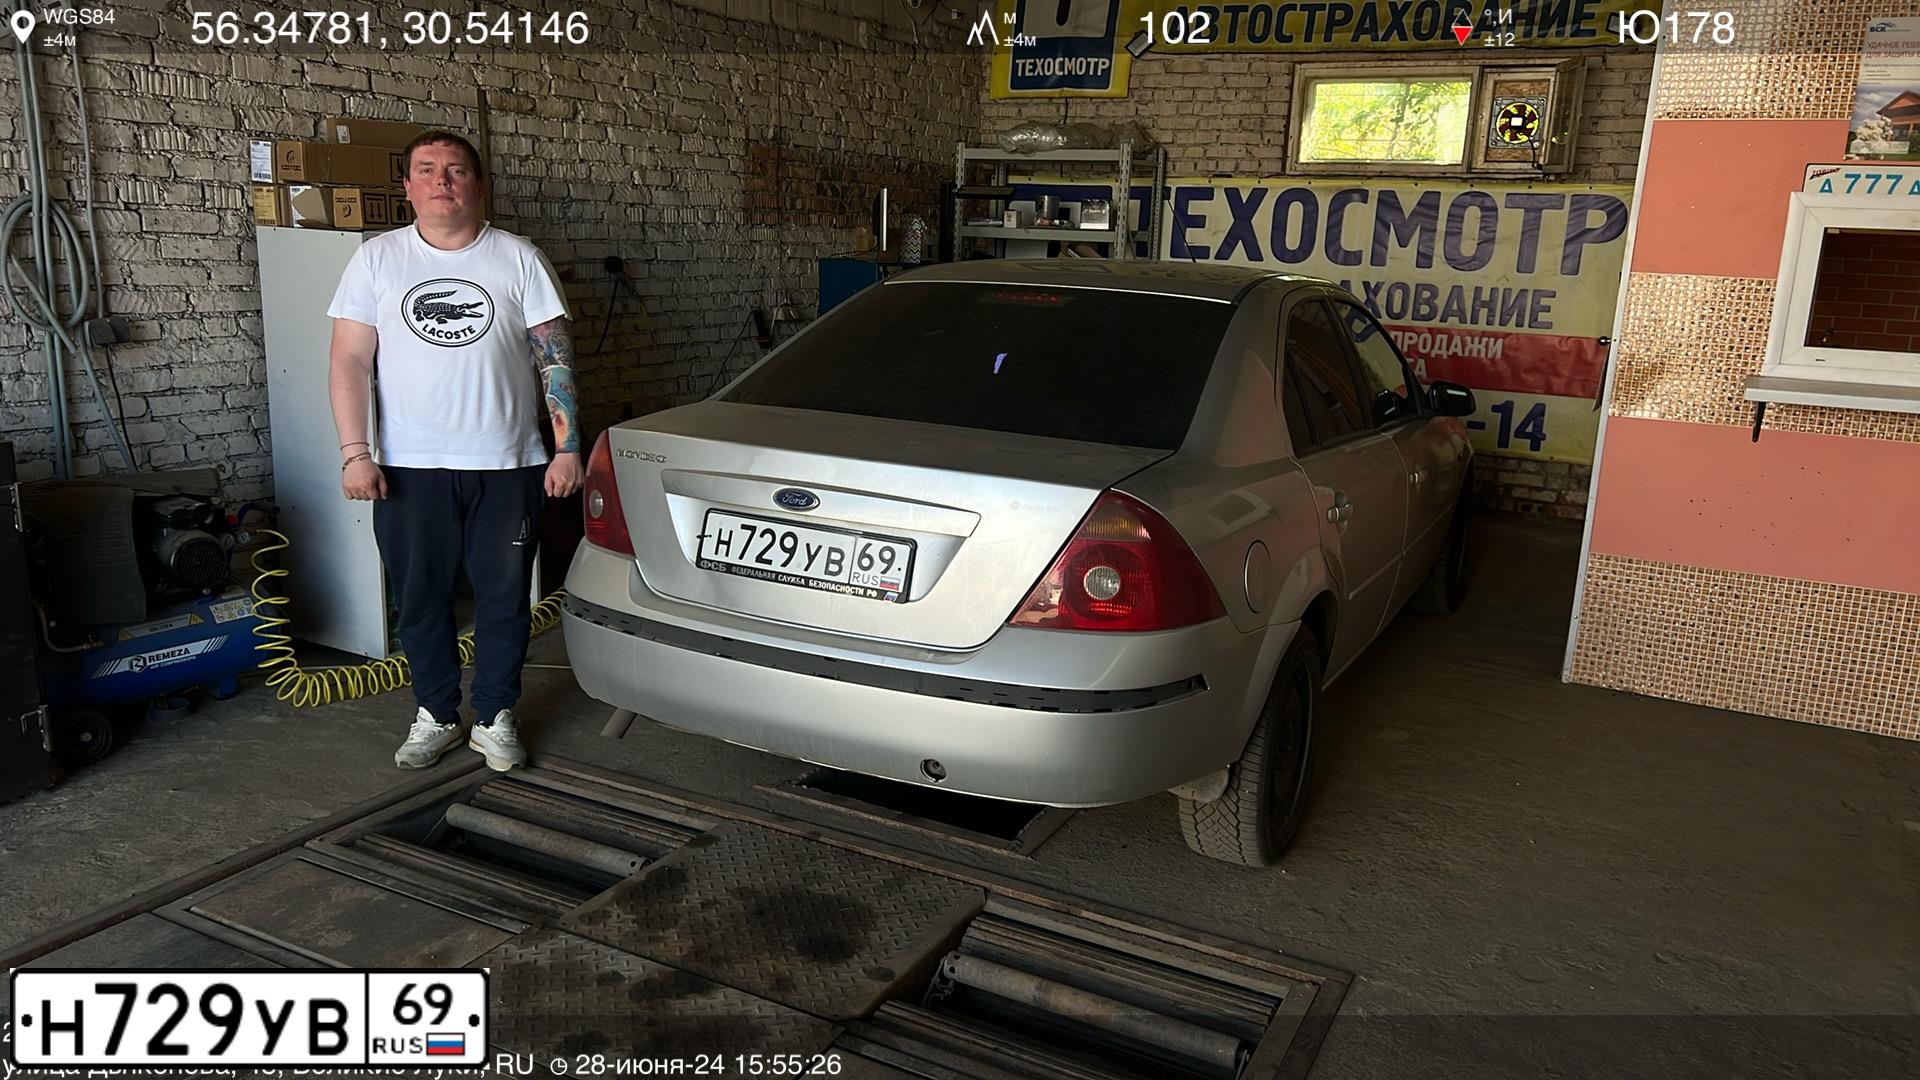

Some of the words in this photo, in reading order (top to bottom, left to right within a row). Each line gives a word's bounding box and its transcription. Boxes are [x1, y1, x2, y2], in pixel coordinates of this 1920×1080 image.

[1166, 0, 1598, 46] АВТОСТРАХОВАНИЕ
[1015, 57, 1111, 78] ТЕХОСМОТР
[1844, 173, 1903, 195] 777
[1129, 186, 1628, 277] ТЕХОСМОТР
[421, 323, 476, 341] LACOSTE
[781, 492, 808, 507] Ford
[714, 524, 846, 577] Н729УВ
[857, 542, 897, 575] 69
[700, 559, 727, 573] ФСБ
[730, 566, 777, 581] ФЕДЕРАЛЬНАЯ
[777, 574, 806, 586] СЛУЖБА
[808, 580, 864, 596] БЕЗОПАСНОСТИ
[866, 588, 879, 598] РФ
[852, 572, 880, 587] RUS
[148, 647, 191, 663] REMEZA
